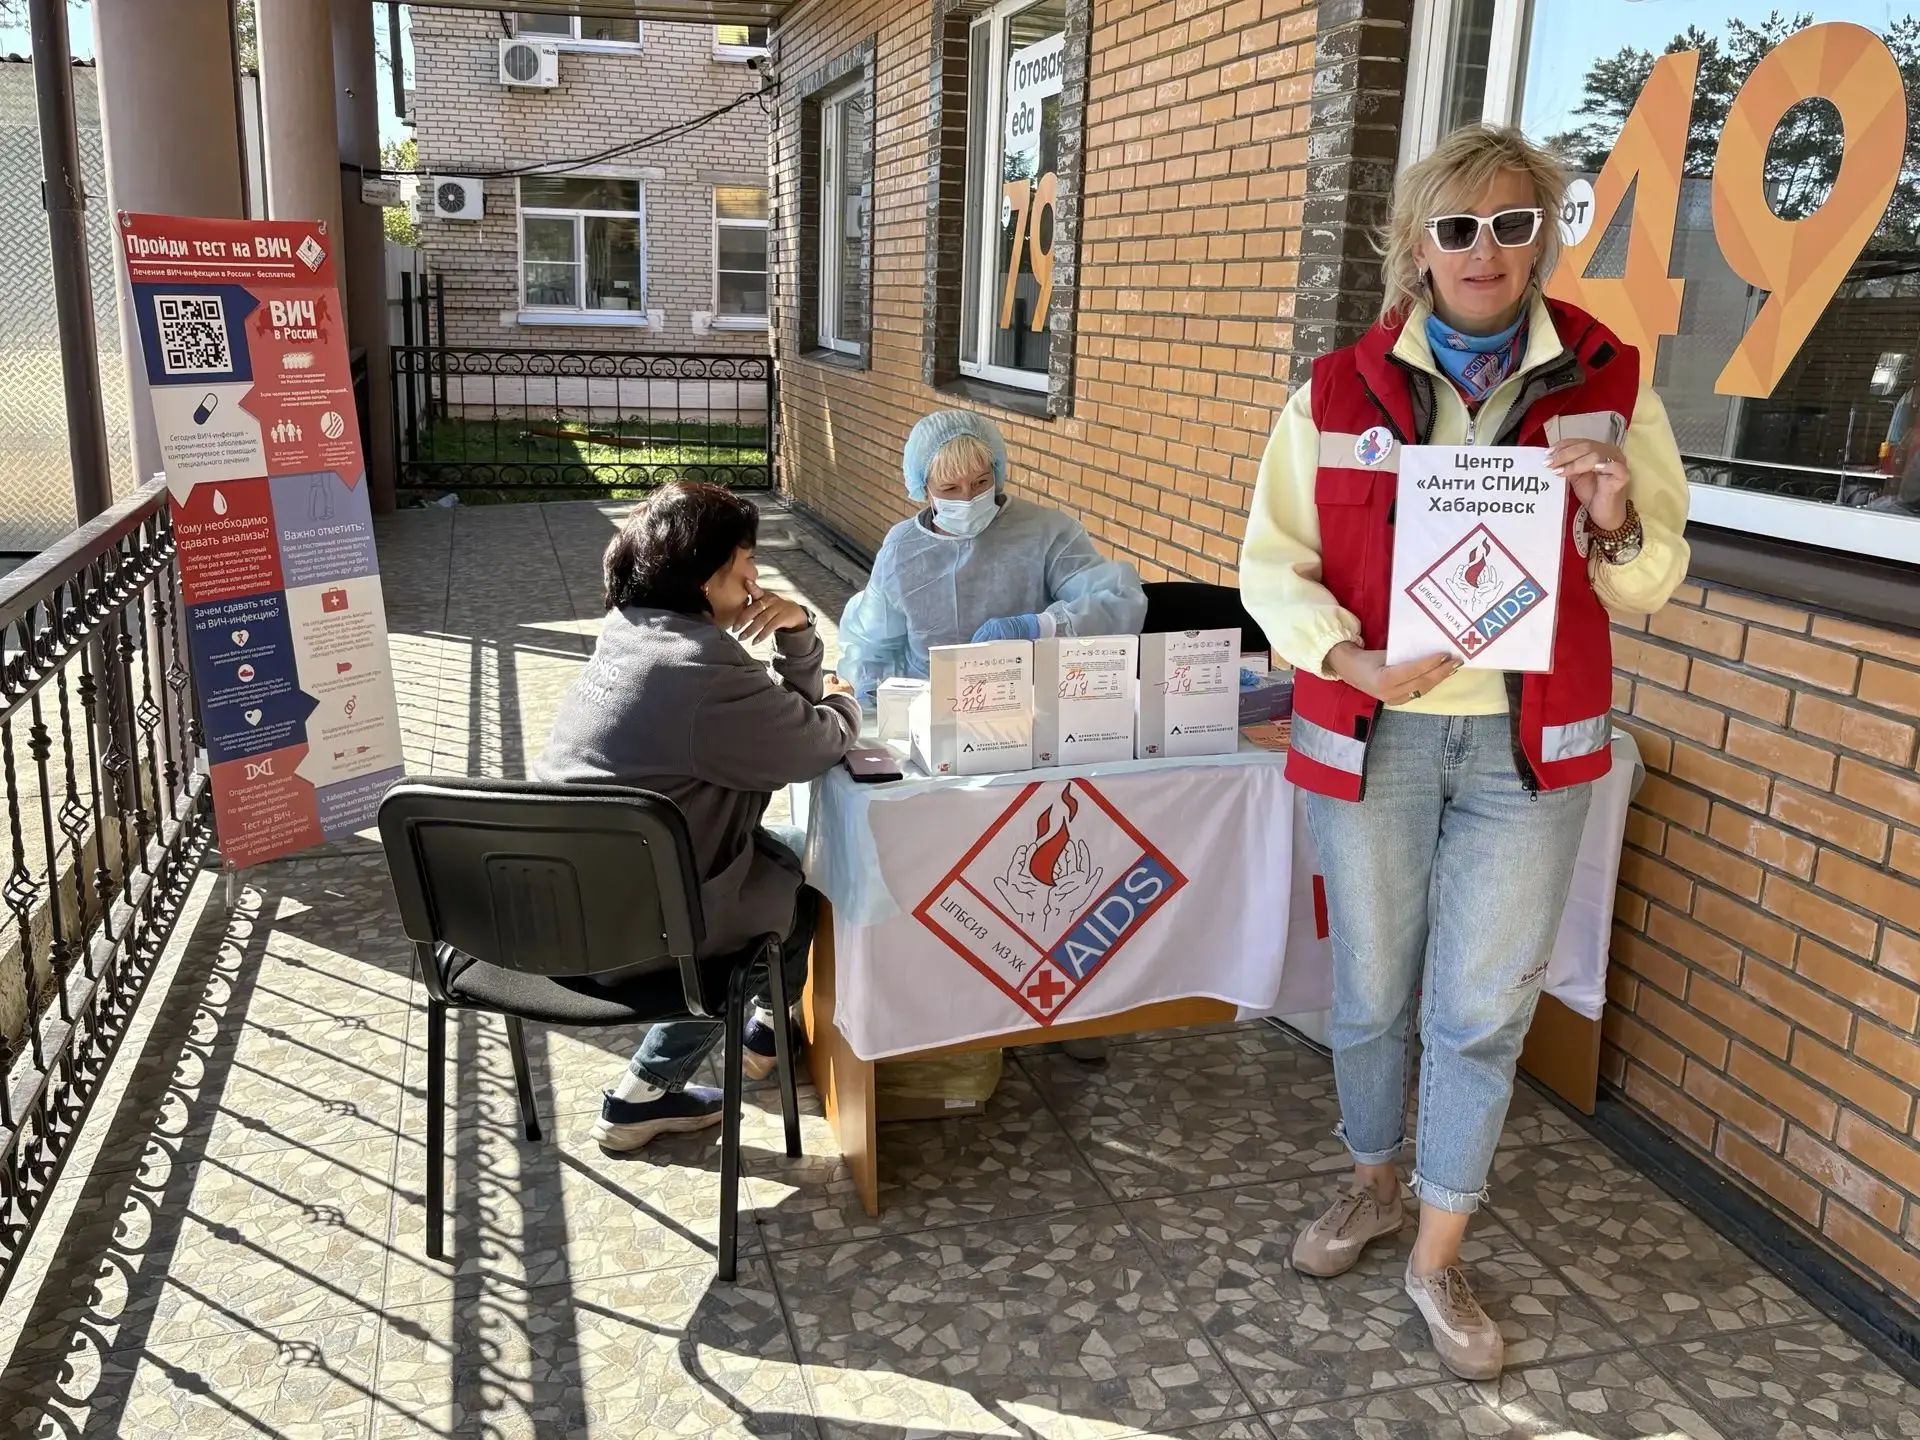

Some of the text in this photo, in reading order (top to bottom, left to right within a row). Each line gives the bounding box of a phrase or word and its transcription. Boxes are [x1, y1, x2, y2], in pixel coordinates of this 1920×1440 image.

[1013, 52, 1064, 92] Готовая
[1012, 102, 1035, 137] еда
[1543, 21, 1908, 399] 49
[127, 234, 292, 258] Пройди тест на ВИЧ
[133, 268, 165, 277] Лечение
[166, 268, 220, 278] ВИЧ-инфекции
[226, 270, 251, 278] России
[257, 271, 296, 279] бесплатное
[269, 300, 316, 326] ВИЧ
[274, 328, 318, 340] в России
[170, 433, 196, 442] Сегодня
[168, 451, 220, 460] контролируемое
[1454, 453, 1514, 472] Центр
[1416, 475, 1550, 495] «Анти СПИД»
[1428, 496, 1536, 516] Хабаровск
[177, 516, 268, 535] Кому необходимо
[284, 522, 365, 540] Важно отметить:
[180, 528, 270, 551] сдавать анализы?
[194, 597, 277, 619] Зачем сдавать тест
[1481, 584, 1537, 639] AIDS
[196, 608, 280, 631] на ВИЧ-инфекцию?
[242, 811, 291, 831] Тест на ВИЧ
[1062, 866, 1164, 980] AIDS
[940, 896, 1028, 973] ЦПБСИЗ МЗ ХК
